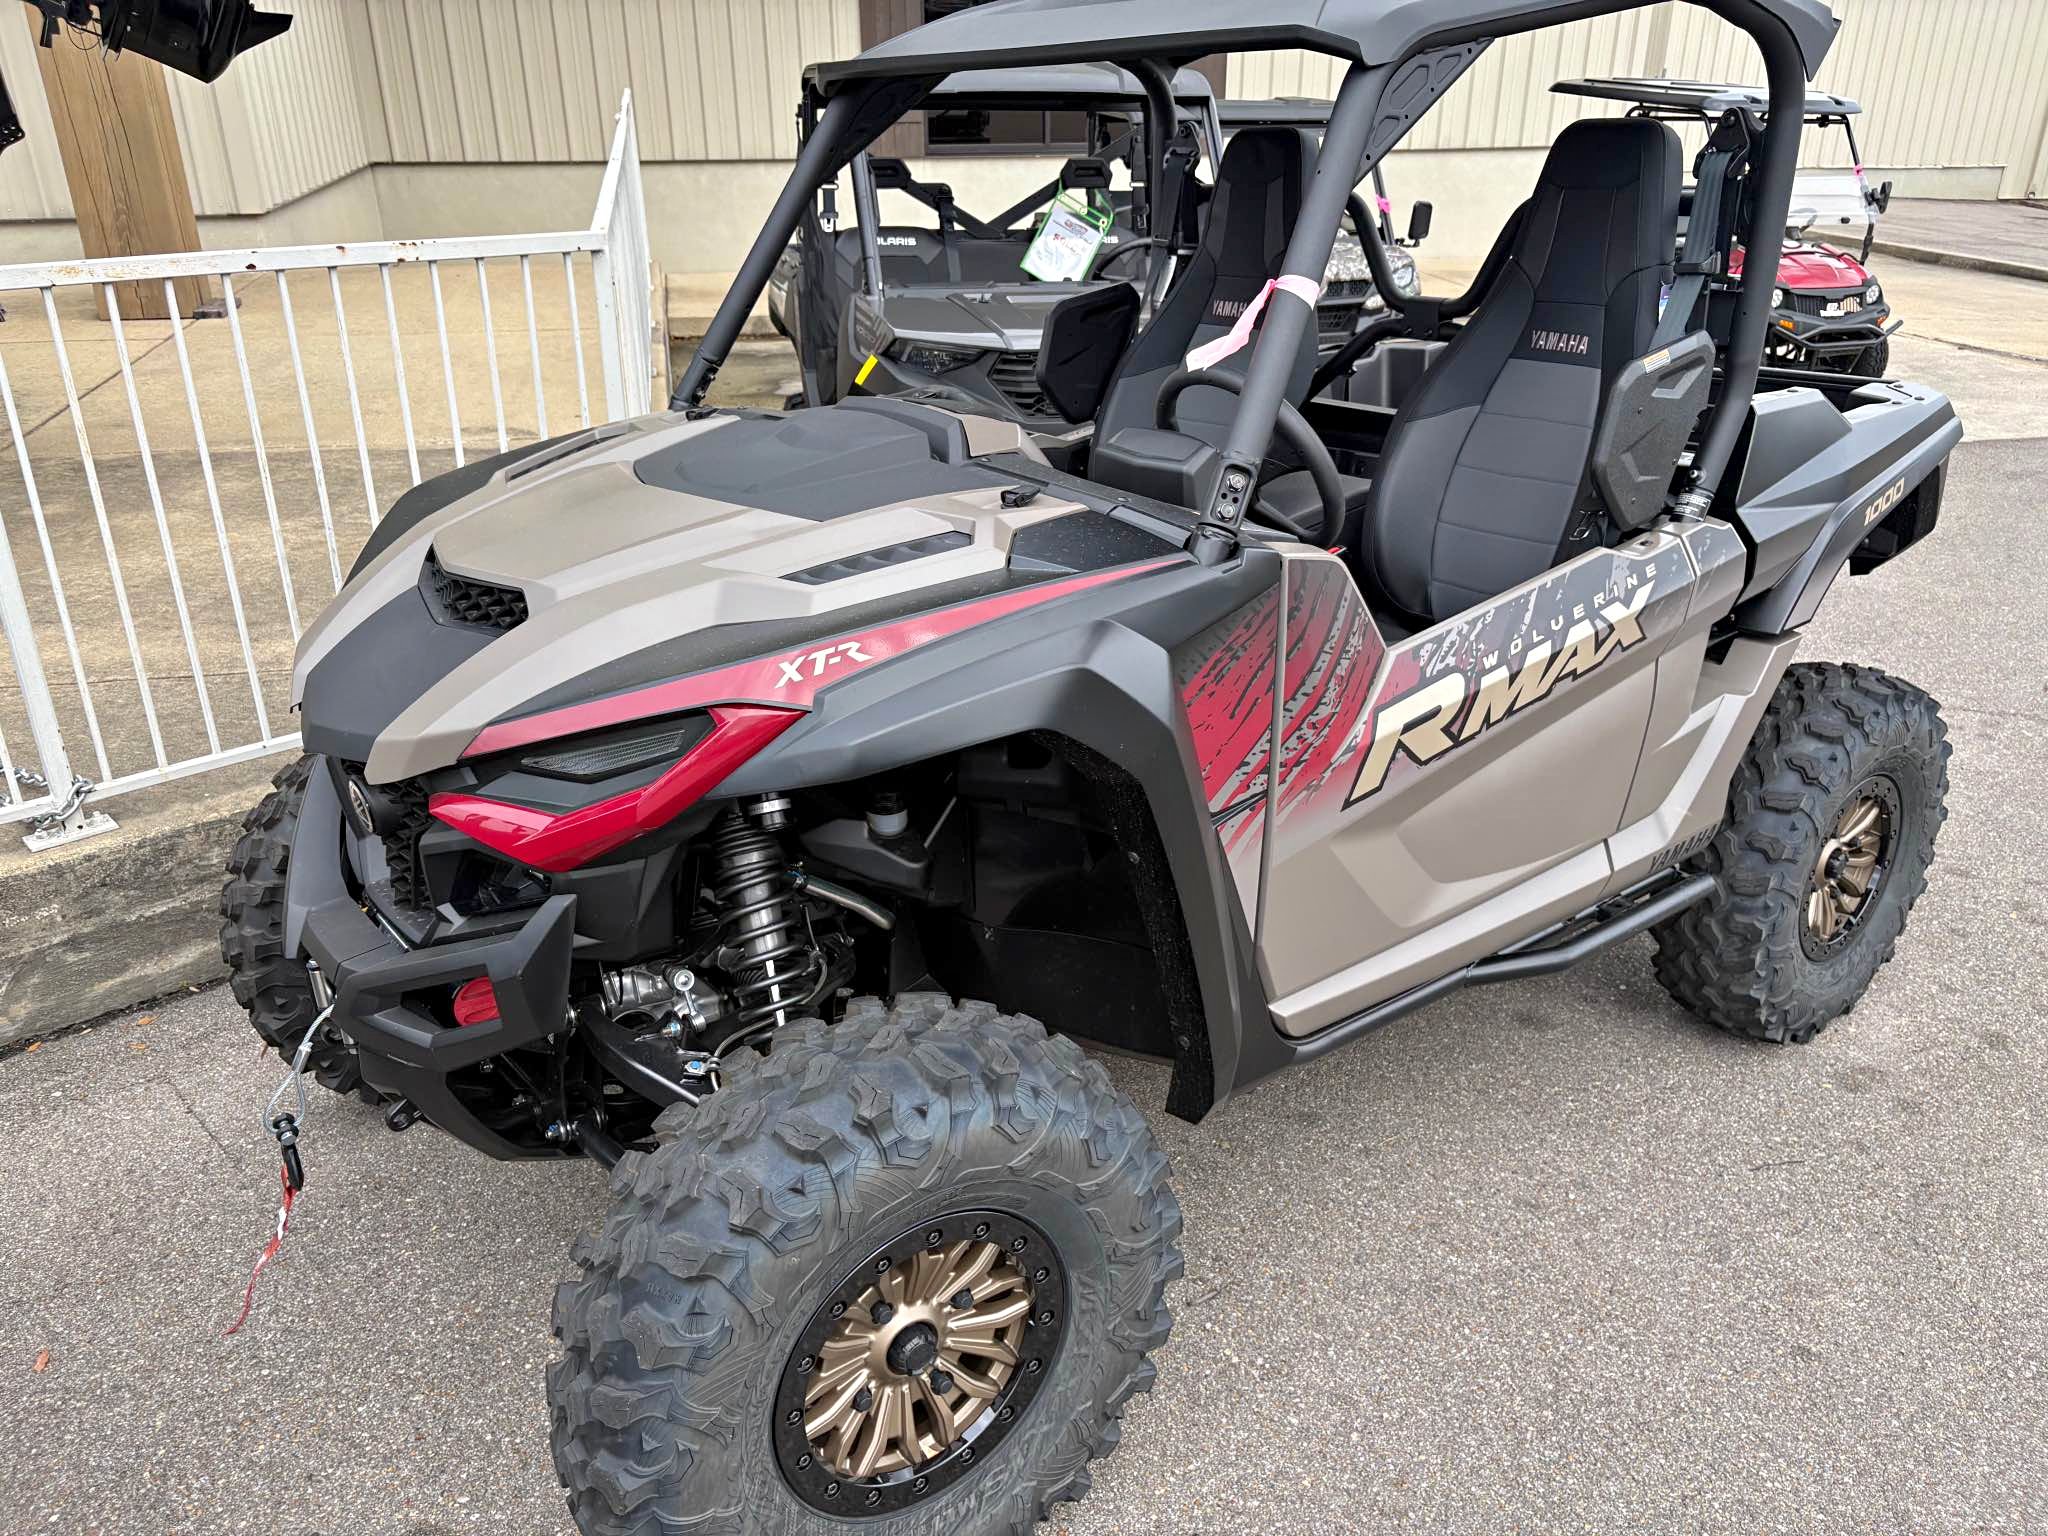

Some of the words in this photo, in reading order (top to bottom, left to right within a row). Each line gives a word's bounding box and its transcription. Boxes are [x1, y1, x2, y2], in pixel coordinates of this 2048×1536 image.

[1213, 299, 1249, 317] YAMAH
[1531, 329, 1589, 355] YAMAHA
[1864, 476, 1905, 526] 1000
[774, 641, 874, 689] XT-R
[1341, 578, 1657, 812] RMAX
